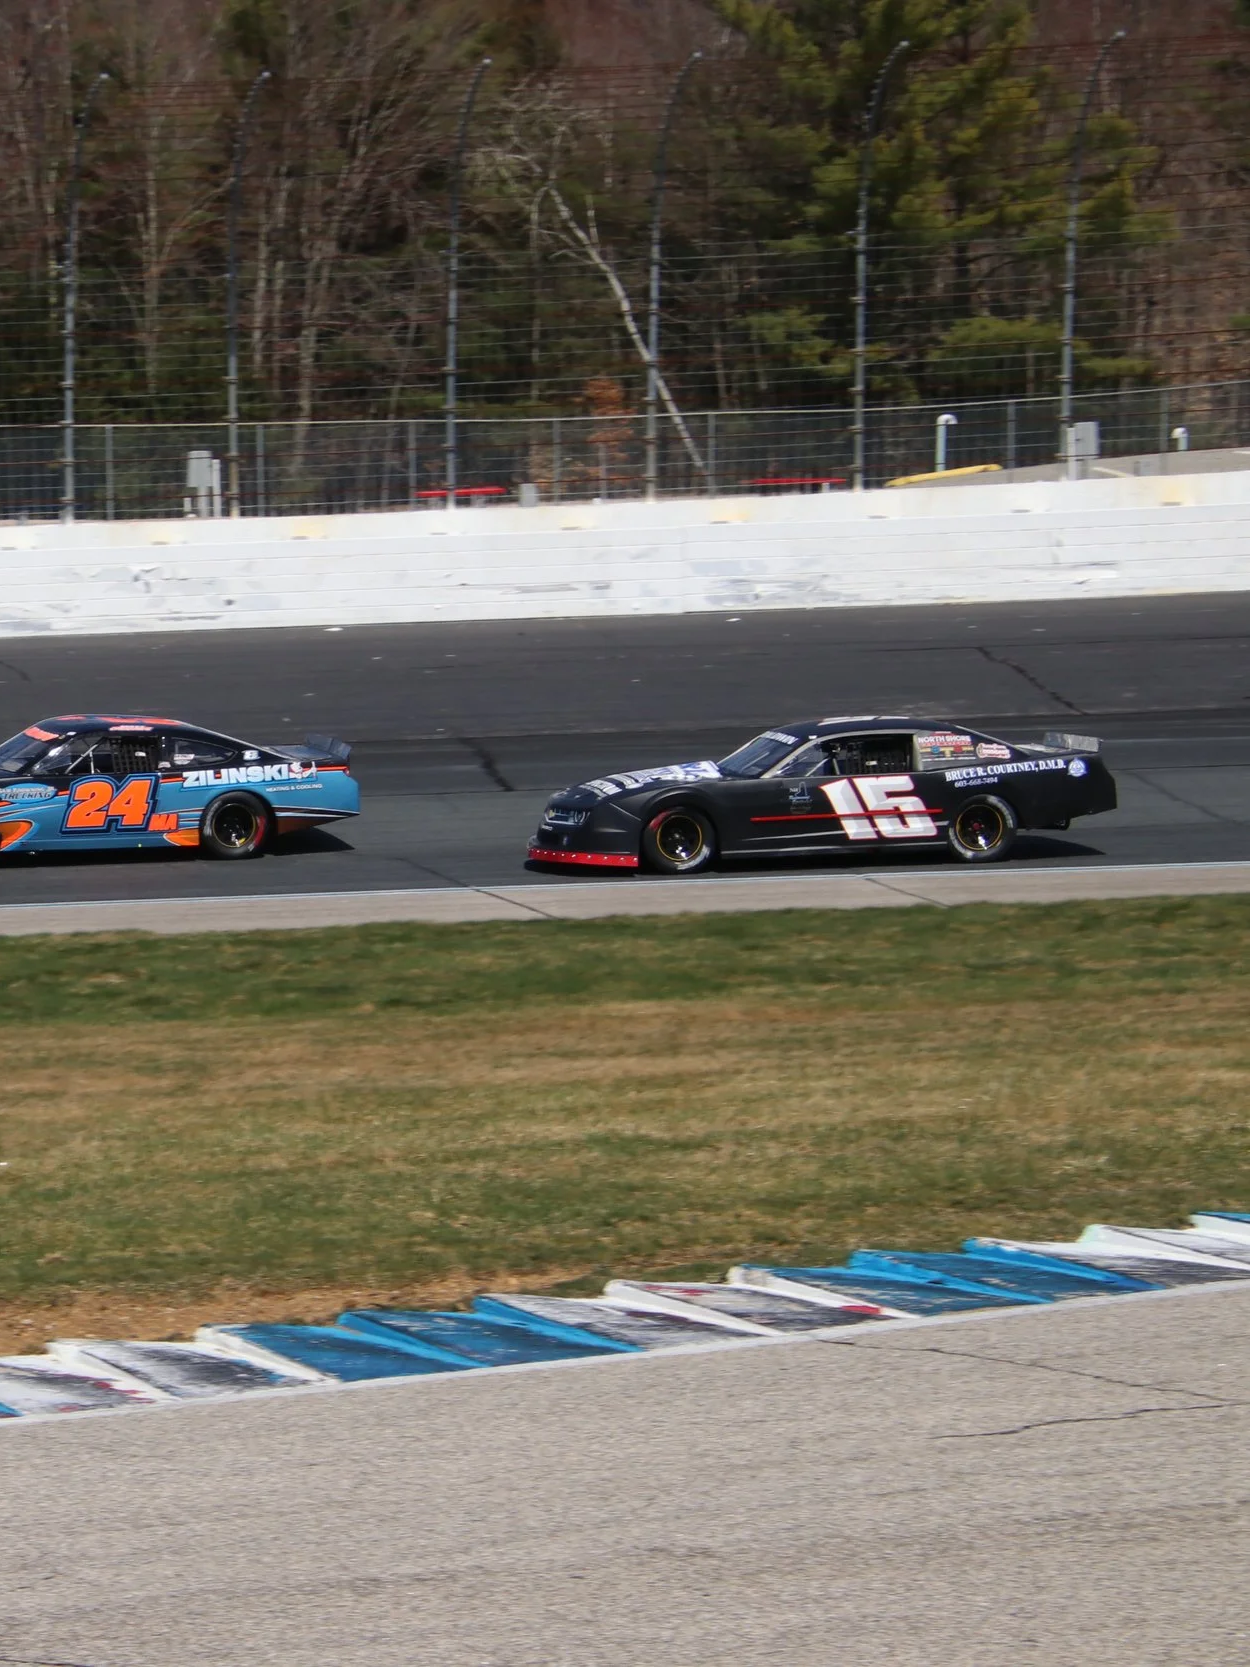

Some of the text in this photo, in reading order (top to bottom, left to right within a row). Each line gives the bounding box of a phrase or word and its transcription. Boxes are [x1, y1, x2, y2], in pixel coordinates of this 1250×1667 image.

[918, 735, 945, 743] NORTH
[182, 763, 290, 788] ZILINSKI
[944, 766, 976, 782] BRUCE
[977, 766, 987, 776] R.
[987, 760, 1039, 777] COURTNEY,
[1039, 758, 1066, 770] D.M.D.
[296, 782, 323, 791] COOLING
[66, 779, 151, 828] 24
[818, 775, 938, 840] 15
